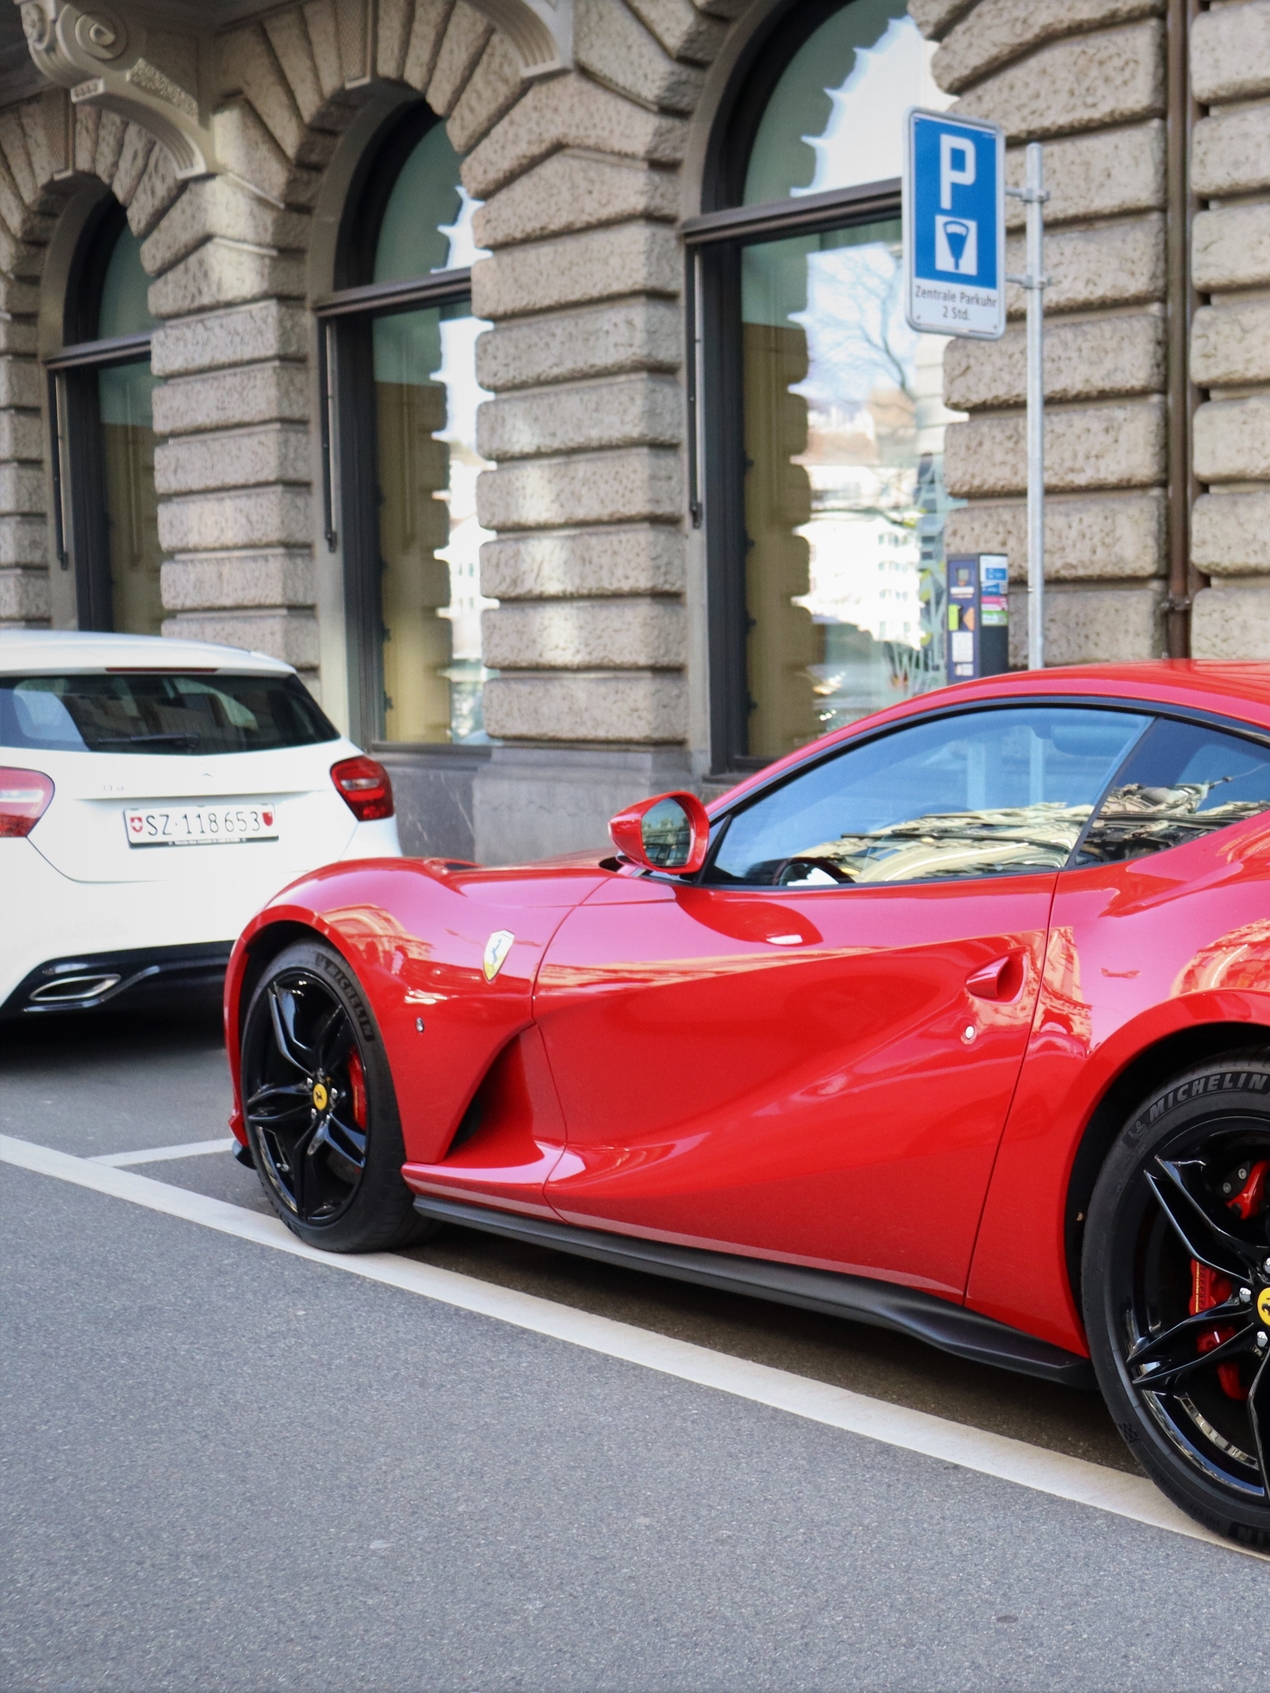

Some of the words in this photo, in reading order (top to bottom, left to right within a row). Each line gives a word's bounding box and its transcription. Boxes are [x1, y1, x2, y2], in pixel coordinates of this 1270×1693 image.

[940, 133, 976, 210] P
[915, 284, 956, 302] Zentrale
[959, 291, 997, 308] Parkuhr
[942, 305, 949, 318] 2
[952, 307, 971, 321] Std.
[1148, 1072, 1270, 1122] MICHELIN
